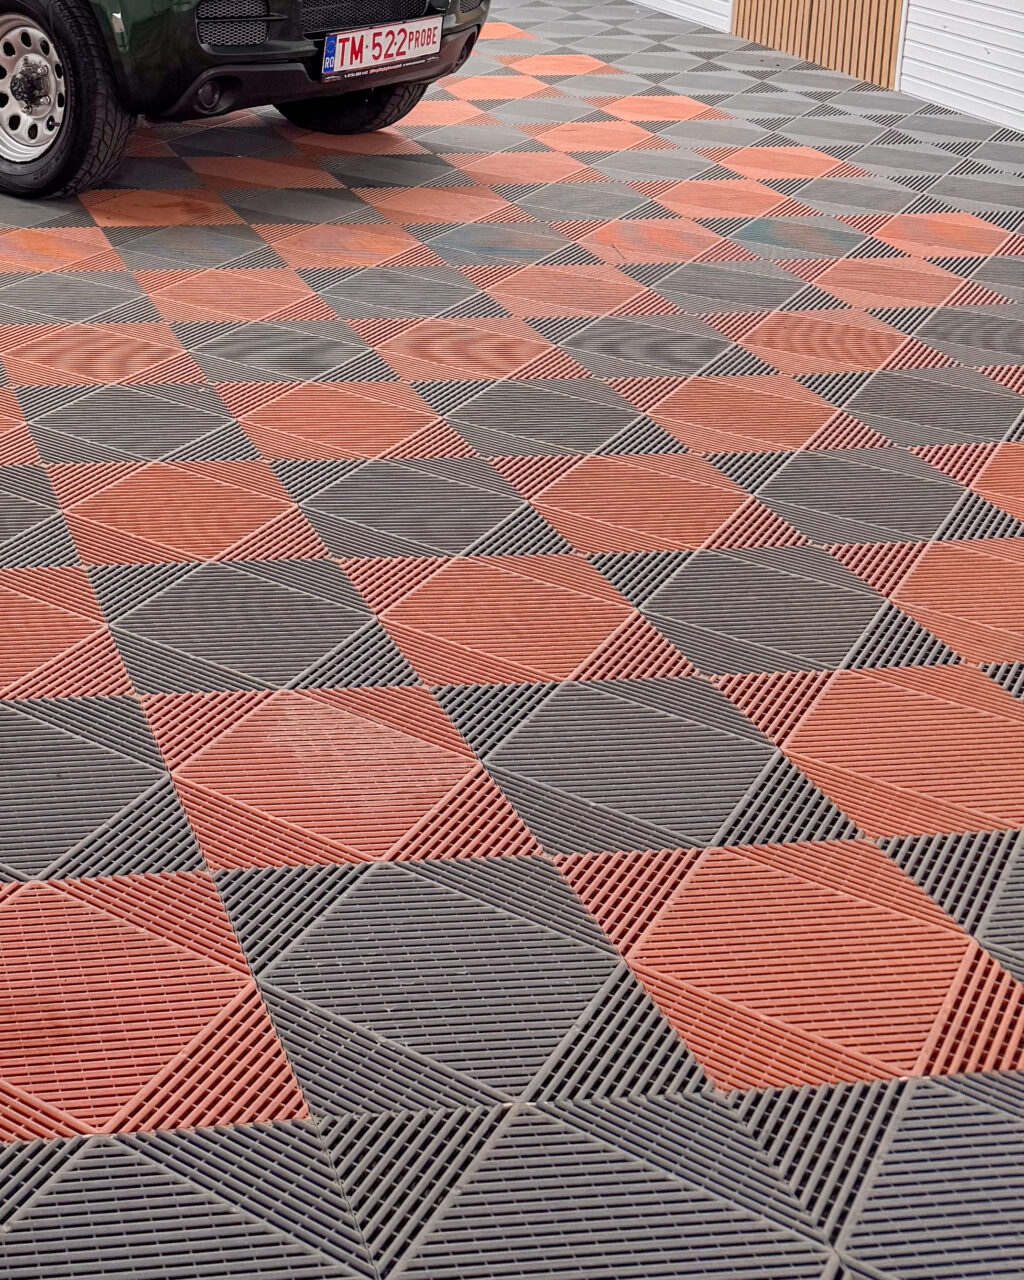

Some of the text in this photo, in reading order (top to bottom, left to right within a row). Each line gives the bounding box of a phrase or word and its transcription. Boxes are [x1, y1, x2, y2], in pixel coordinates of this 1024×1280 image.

[338, 26, 439, 67] TM 522 PROBE
[324, 56, 335, 69] RO
